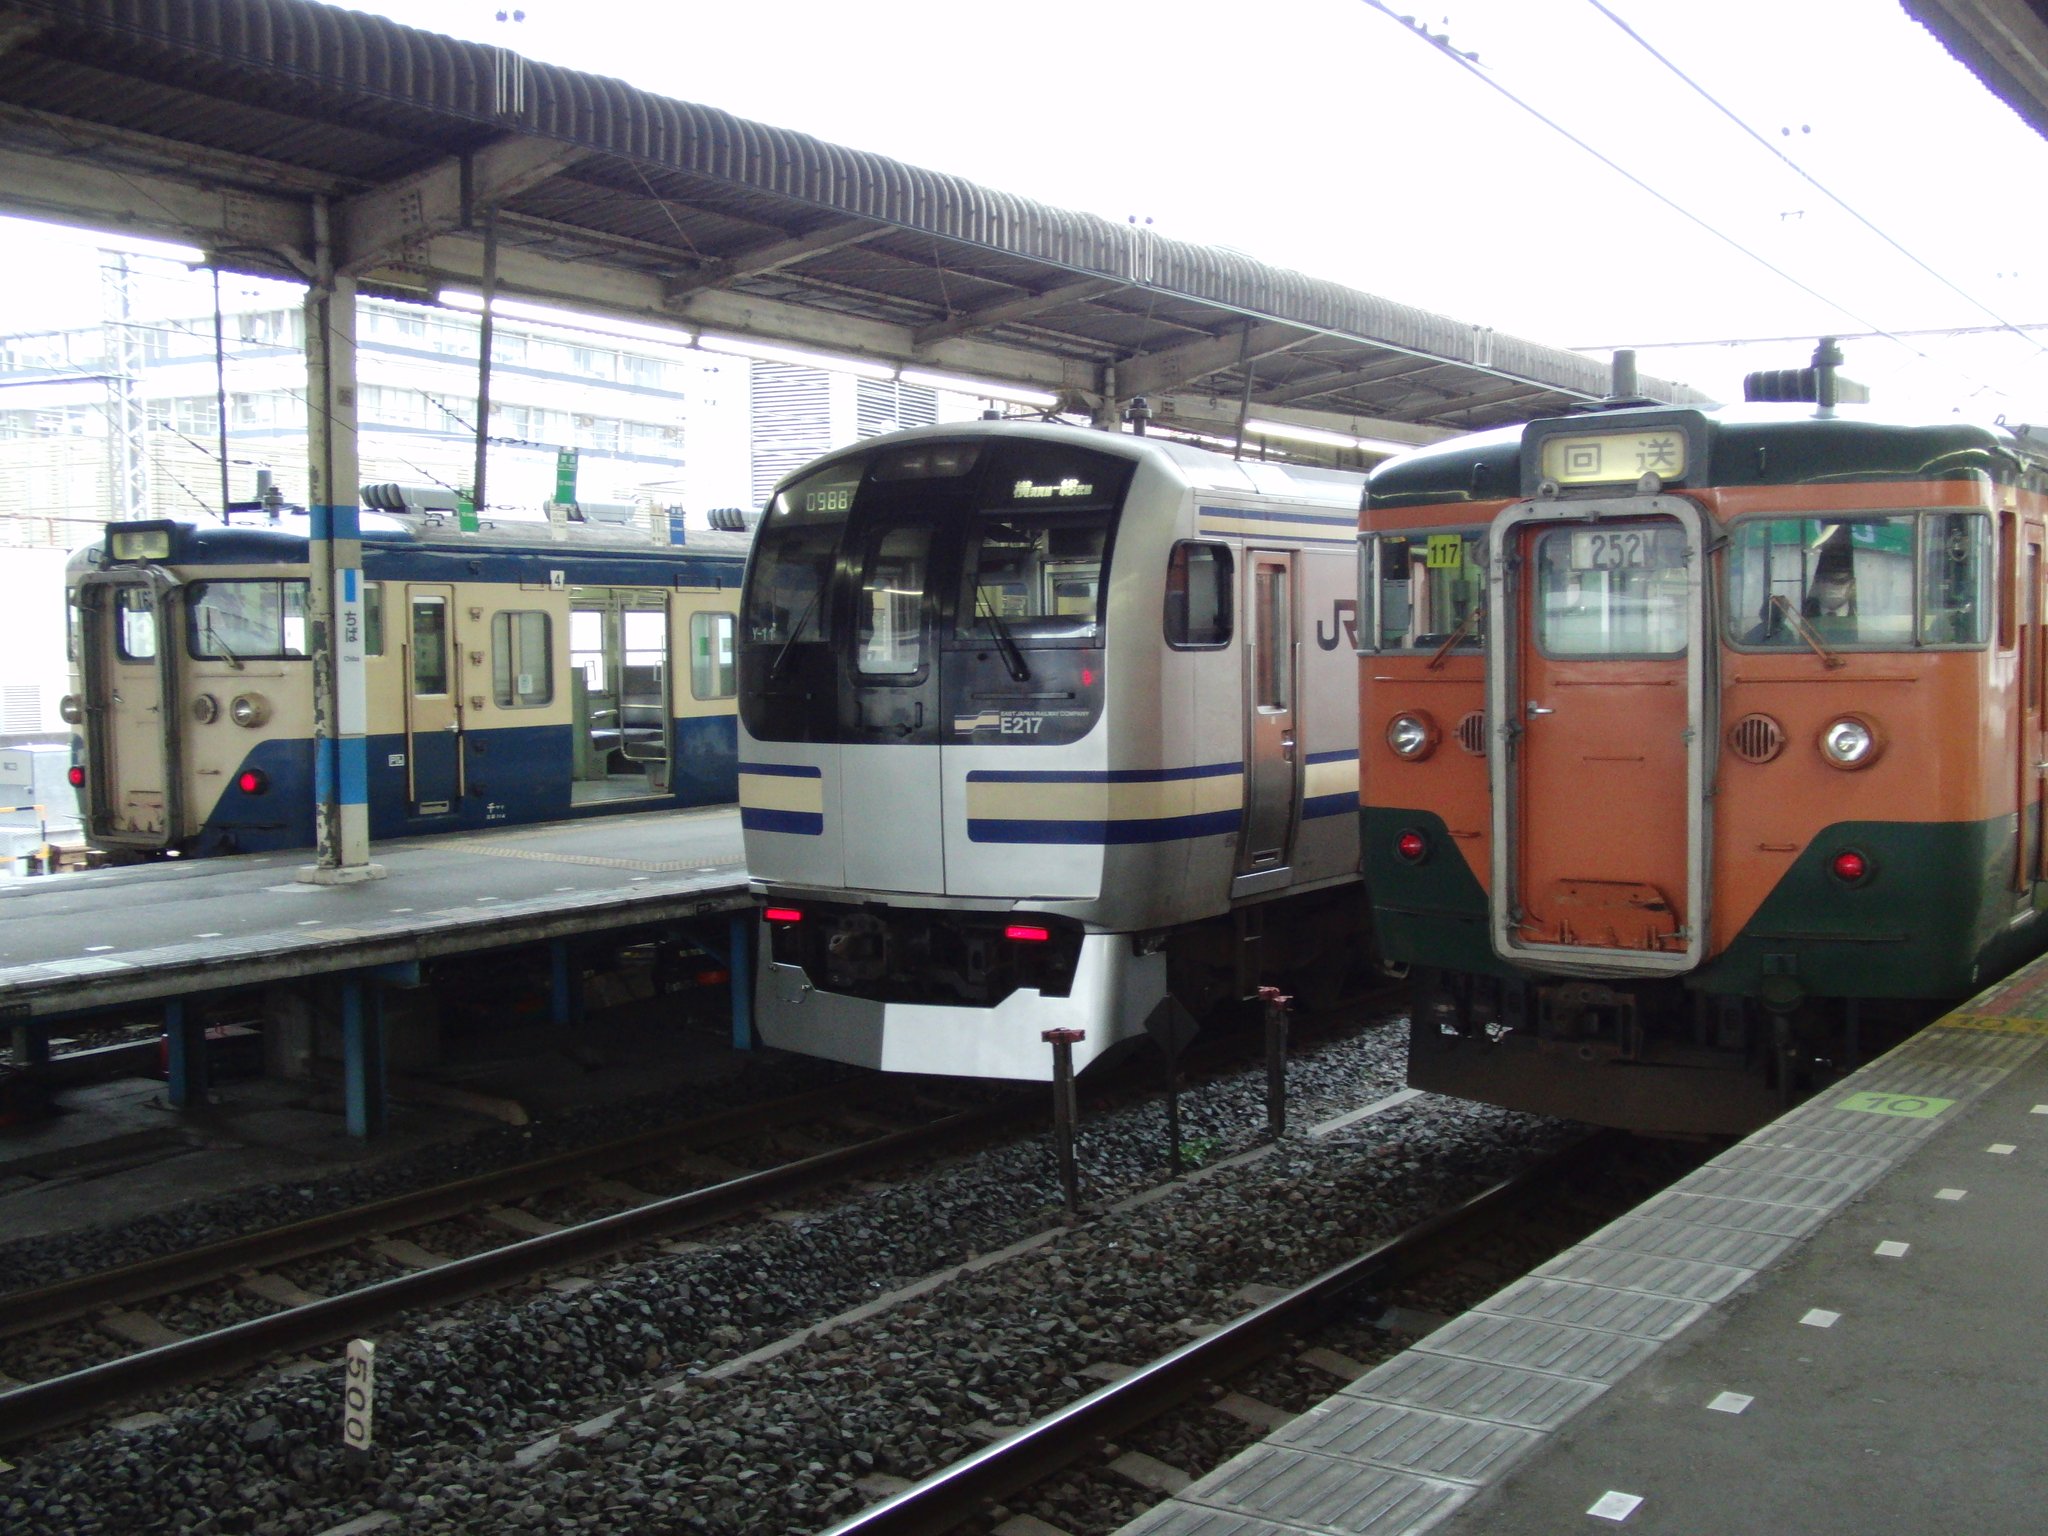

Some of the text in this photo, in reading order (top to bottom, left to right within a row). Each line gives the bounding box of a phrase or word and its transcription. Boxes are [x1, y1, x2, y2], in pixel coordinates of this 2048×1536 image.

[1564, 437, 1676, 476] 回送
[1431, 543, 1458, 564] 117
[554, 573, 561, 587] 4
[344, 610, 358, 643] ちば
[1317, 599, 1359, 651] JR
[1001, 717, 1044, 734] E217
[1866, 1097, 1928, 1113] 10
[346, 1356, 367, 1442] 500
